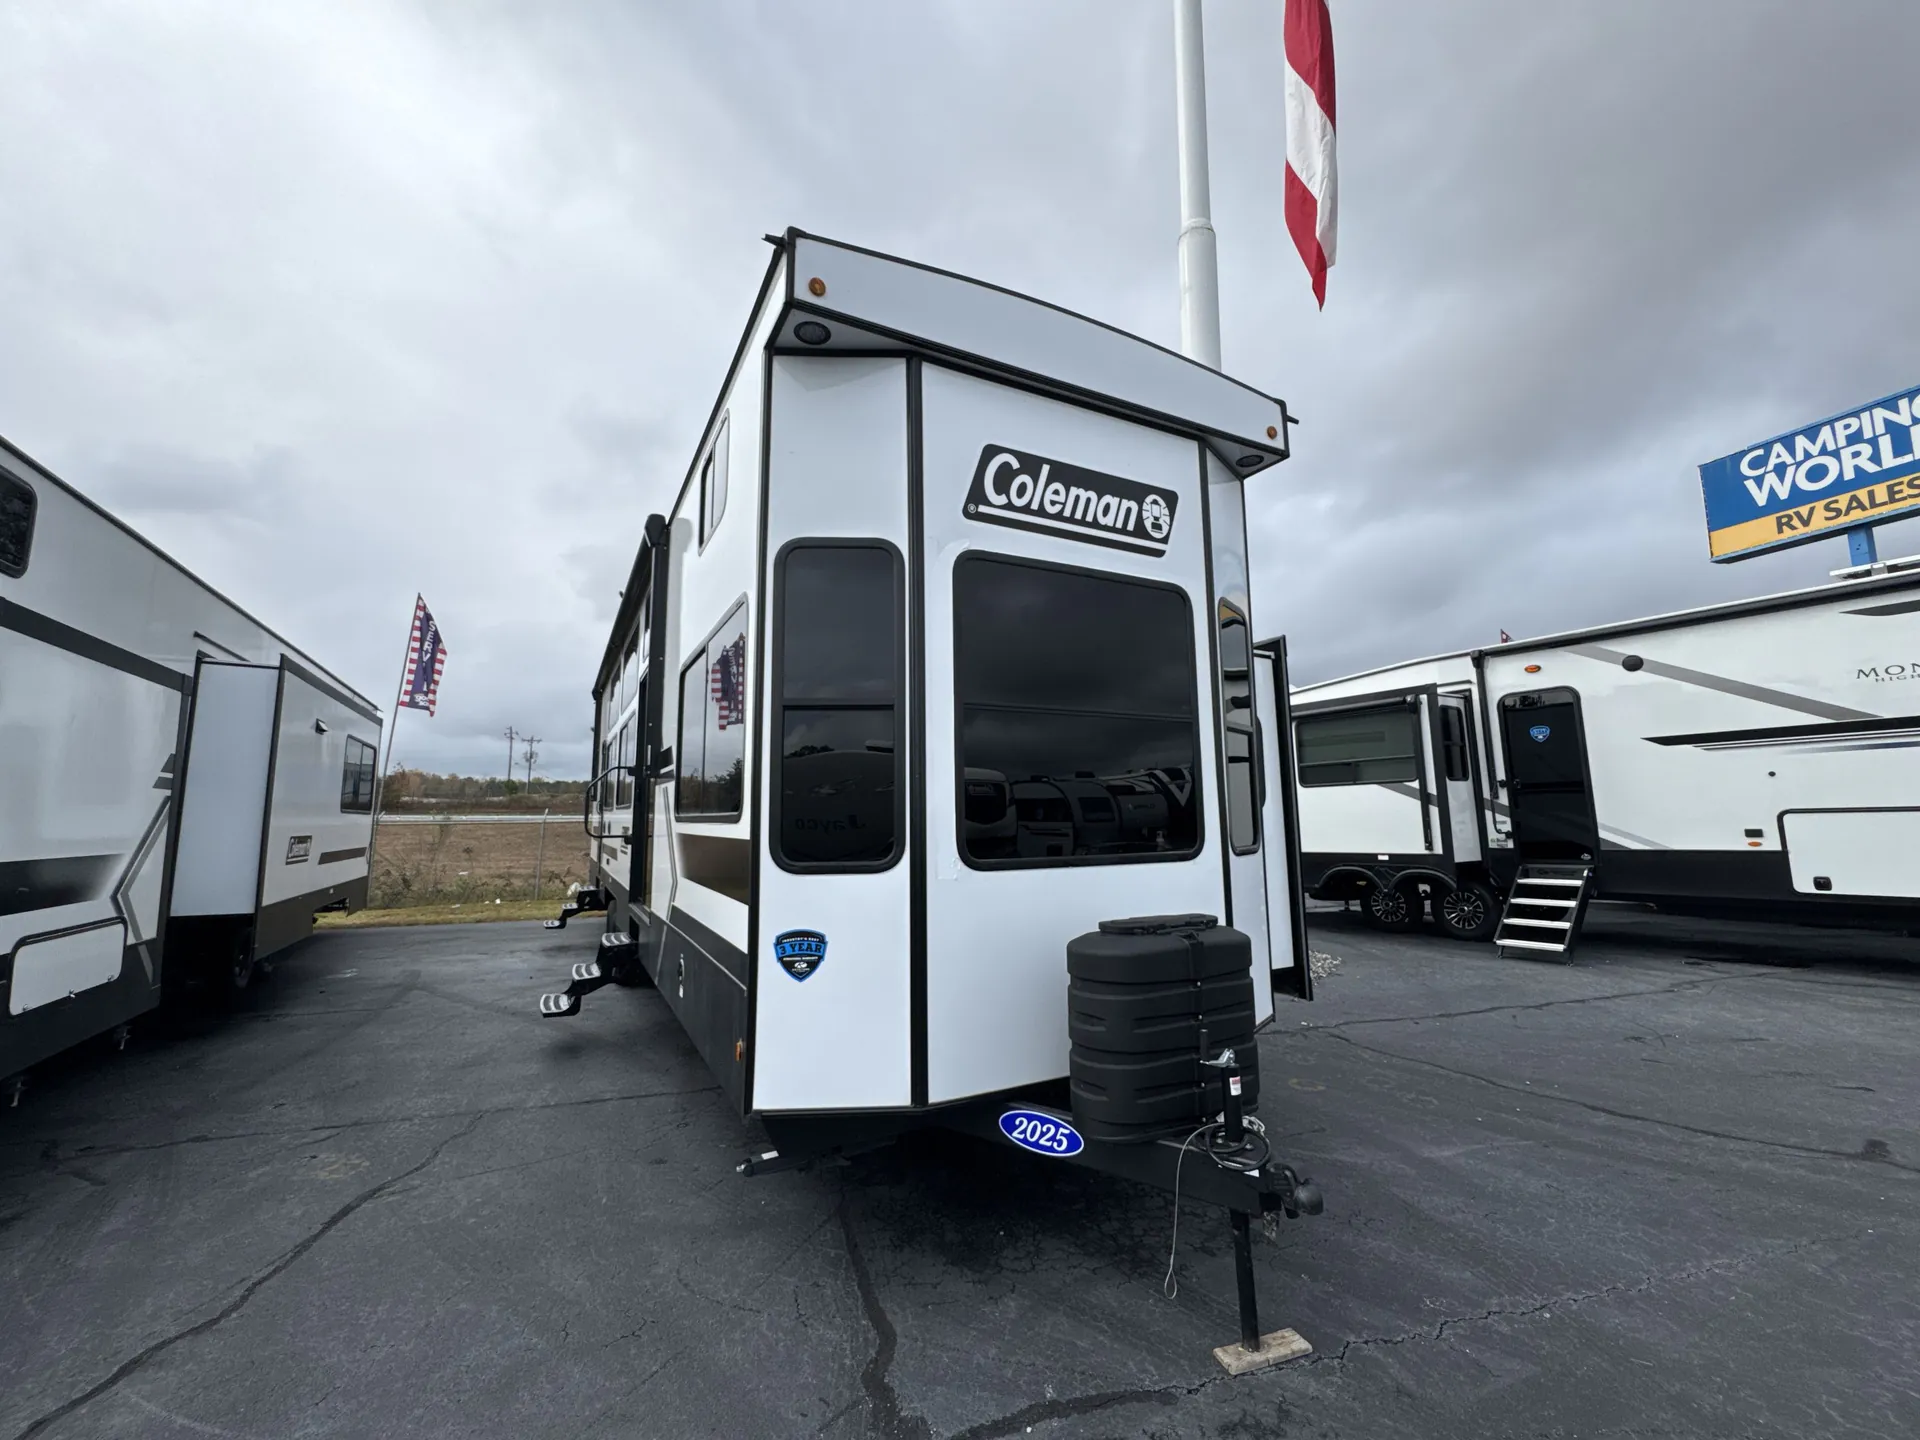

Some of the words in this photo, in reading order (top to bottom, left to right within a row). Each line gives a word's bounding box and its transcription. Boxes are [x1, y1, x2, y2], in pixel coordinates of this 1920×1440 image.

[984, 452, 1139, 532] Coleman
[1775, 506, 1816, 535] RV
[1824, 475, 1920, 522] SALES
[779, 945, 786, 955] 3
[789, 943, 822, 953] YEAR
[1011, 1117, 1071, 1151] 2025
